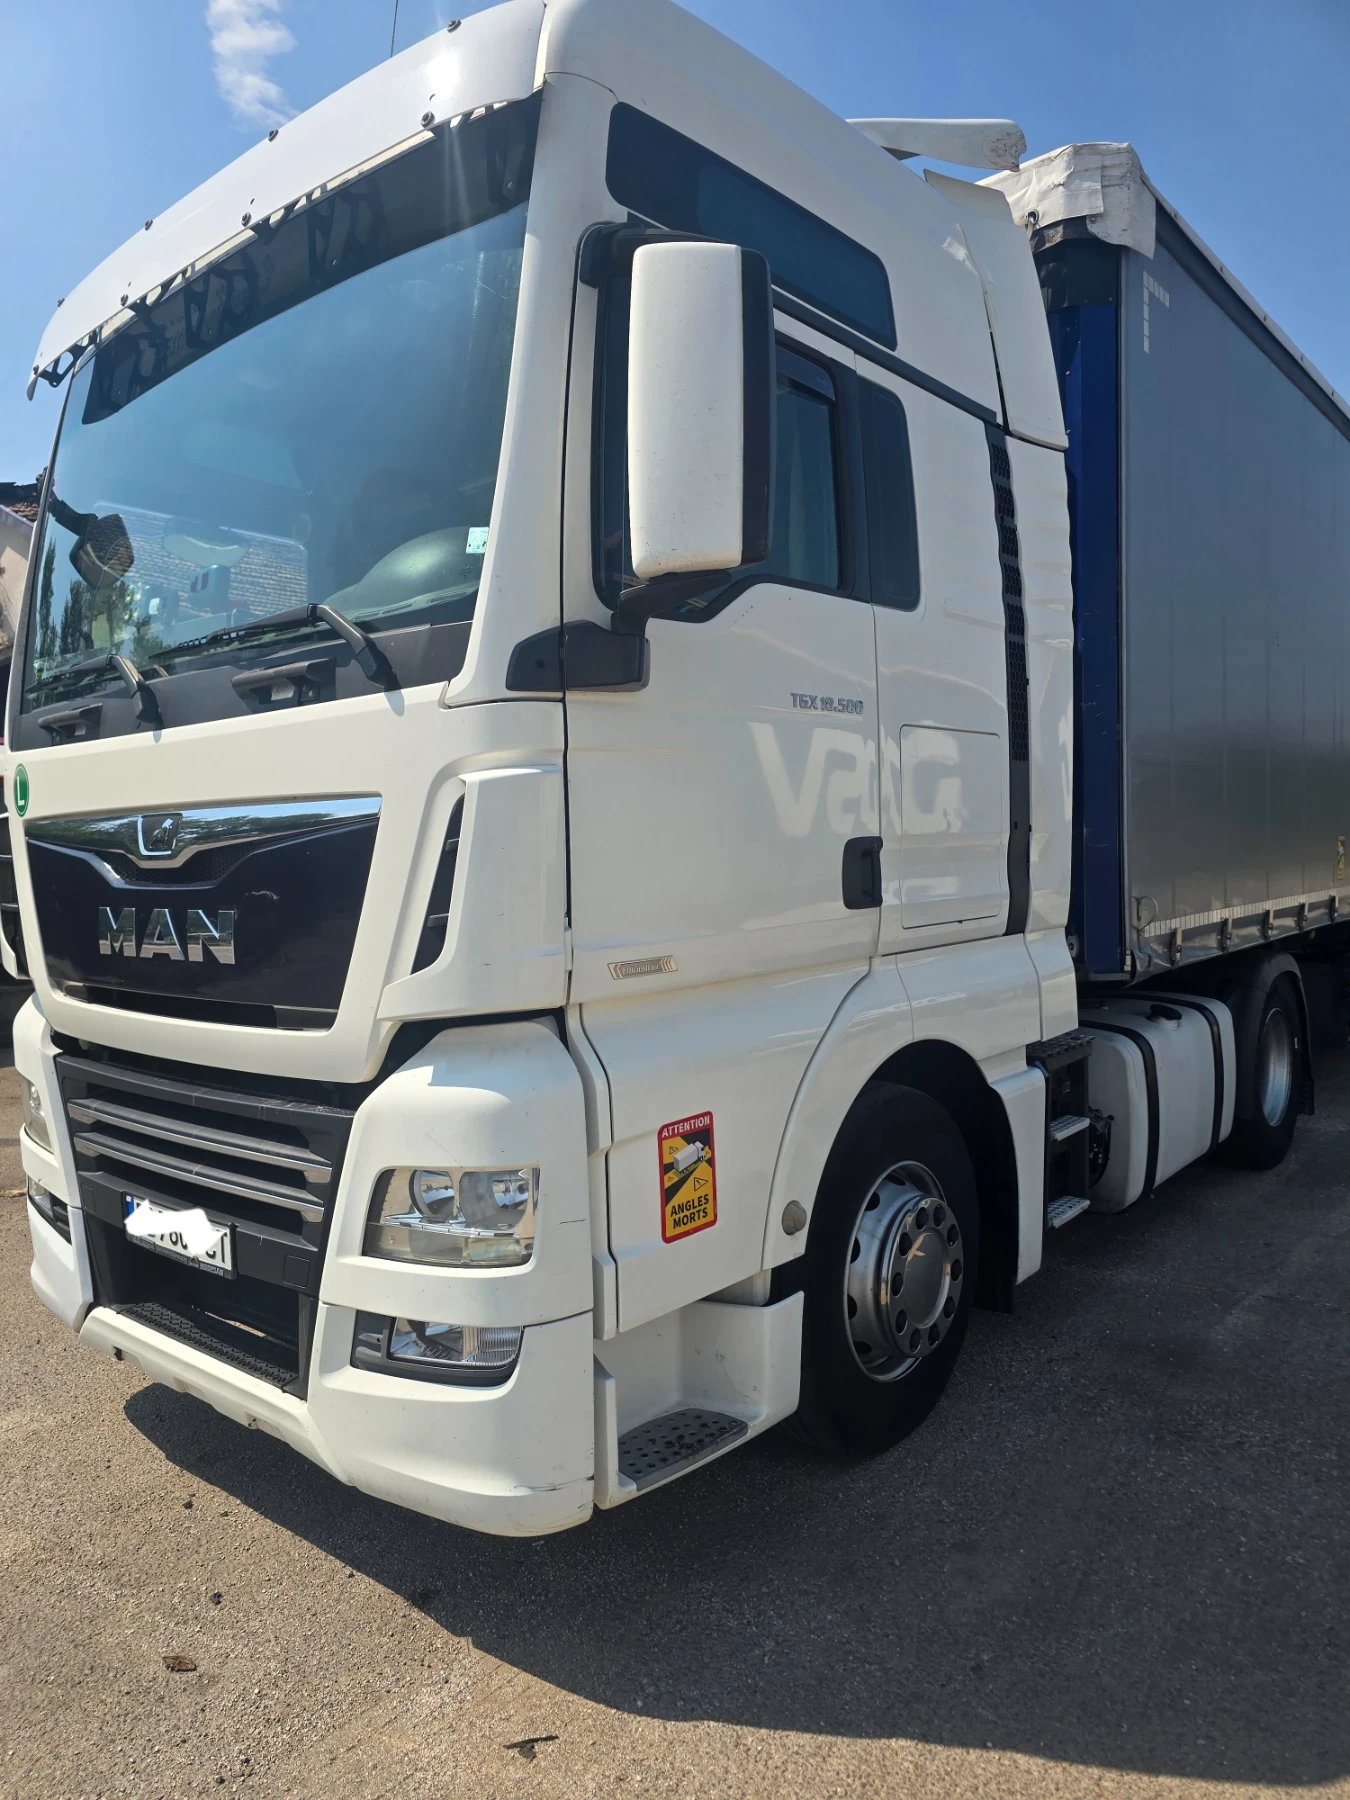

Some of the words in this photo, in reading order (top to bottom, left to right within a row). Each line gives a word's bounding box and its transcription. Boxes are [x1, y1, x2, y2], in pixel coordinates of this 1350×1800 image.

[790, 692, 818, 710] TGX
[820, 696, 864, 714] 18.500
[16, 775, 25, 806] L
[98, 906, 236, 965] MAN
[661, 1115, 711, 1138] ATTENTION
[670, 1194, 710, 1218] ANGLES
[672, 1207, 709, 1230] MORTS
